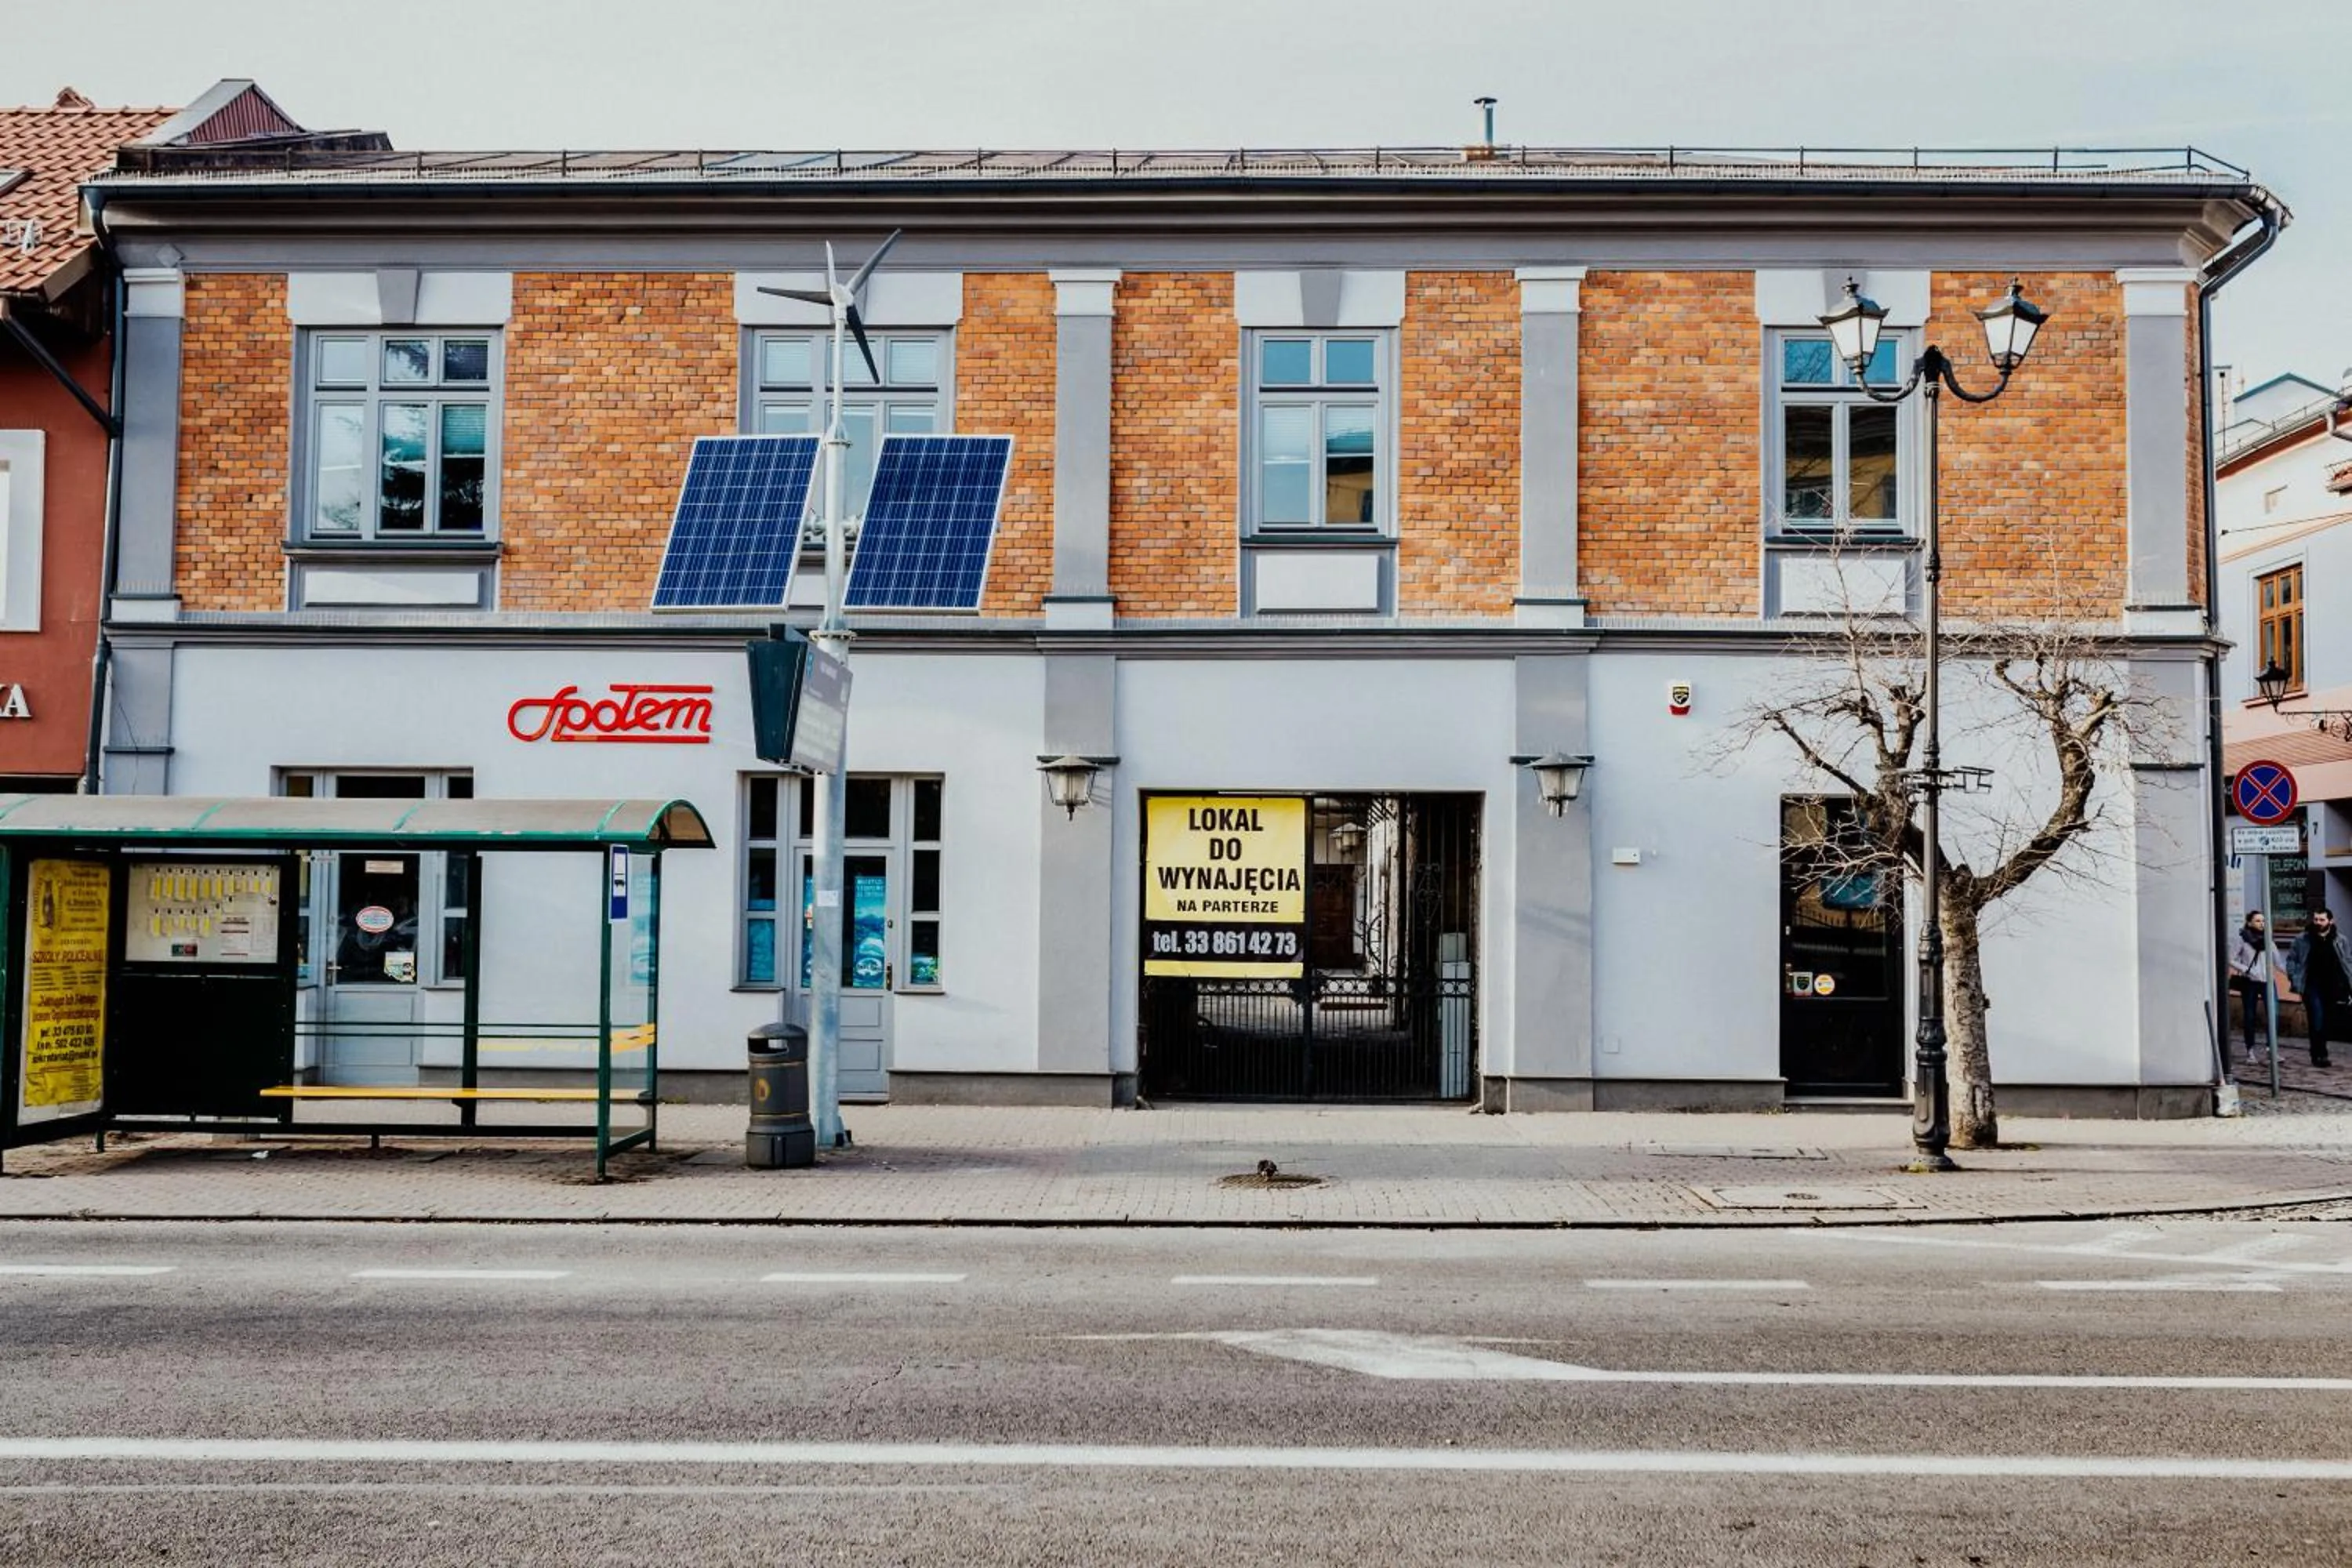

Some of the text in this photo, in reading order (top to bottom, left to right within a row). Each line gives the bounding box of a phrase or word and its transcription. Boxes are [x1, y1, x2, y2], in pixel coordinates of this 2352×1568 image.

[0, 683, 32, 717] A
[1189, 807, 1264, 832] LOKAL
[2312, 821, 2318, 836] 7
[1210, 837, 1242, 862] DO
[1157, 866, 1301, 896] WYNAJĘCIA
[1177, 899, 1279, 913] NA PARTERZE
[1152, 931, 1181, 953] tel.
[1185, 931, 1209, 954] 33
[1275, 932, 1296, 955] 73
